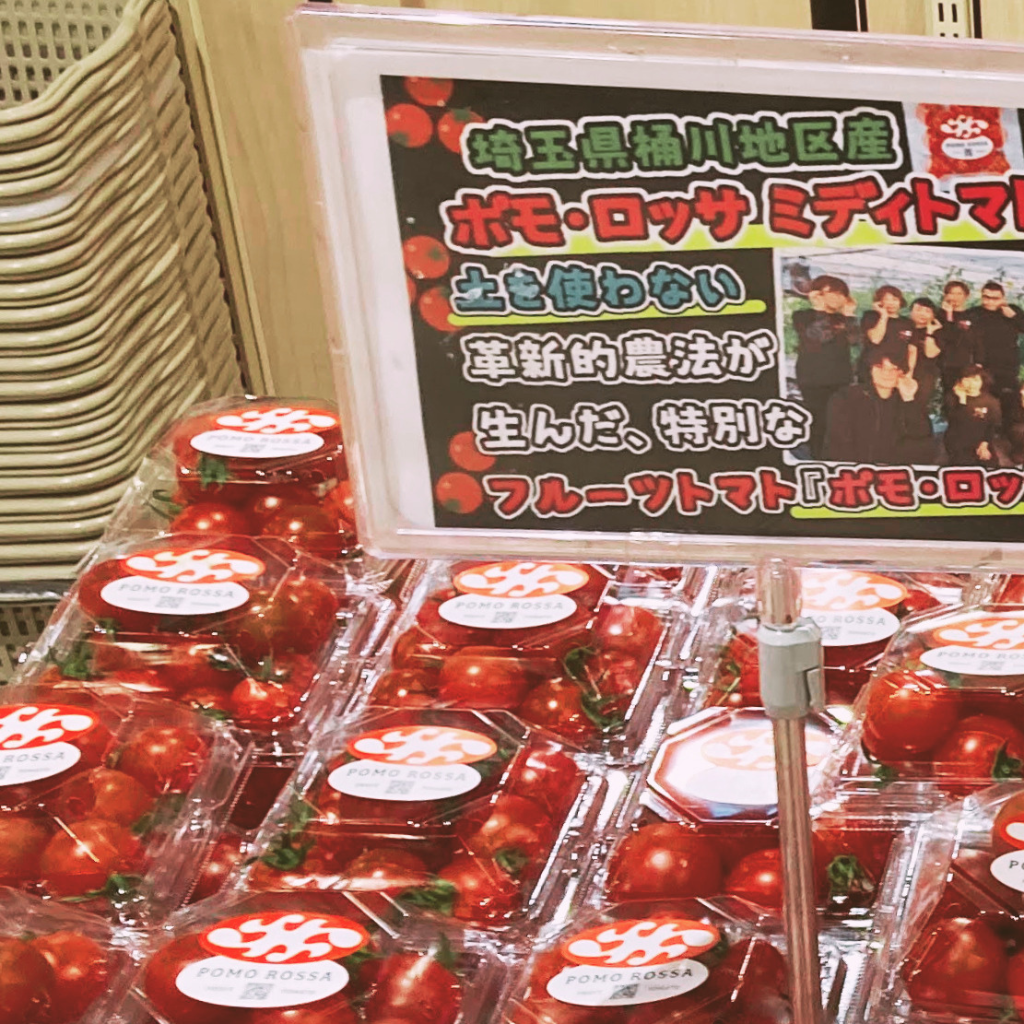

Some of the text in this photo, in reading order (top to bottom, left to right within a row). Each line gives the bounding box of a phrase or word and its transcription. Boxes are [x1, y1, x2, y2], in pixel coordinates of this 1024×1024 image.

[470, 114, 894, 174] 埼玉県桶川地区産
[450, 184, 748, 246] ポモ・ロッサ
[455, 265, 742, 310] 土を使わない
[467, 333, 773, 381] 革新的農法が
[478, 402, 806, 449] 生んだ、特別な
[120, 584, 234, 597] POMO ROSSA
[346, 769, 466, 780] POMO ROSSA
[197, 968, 331, 981] POMO ROSSA
[566, 969, 693, 984] POMO ROSSA
